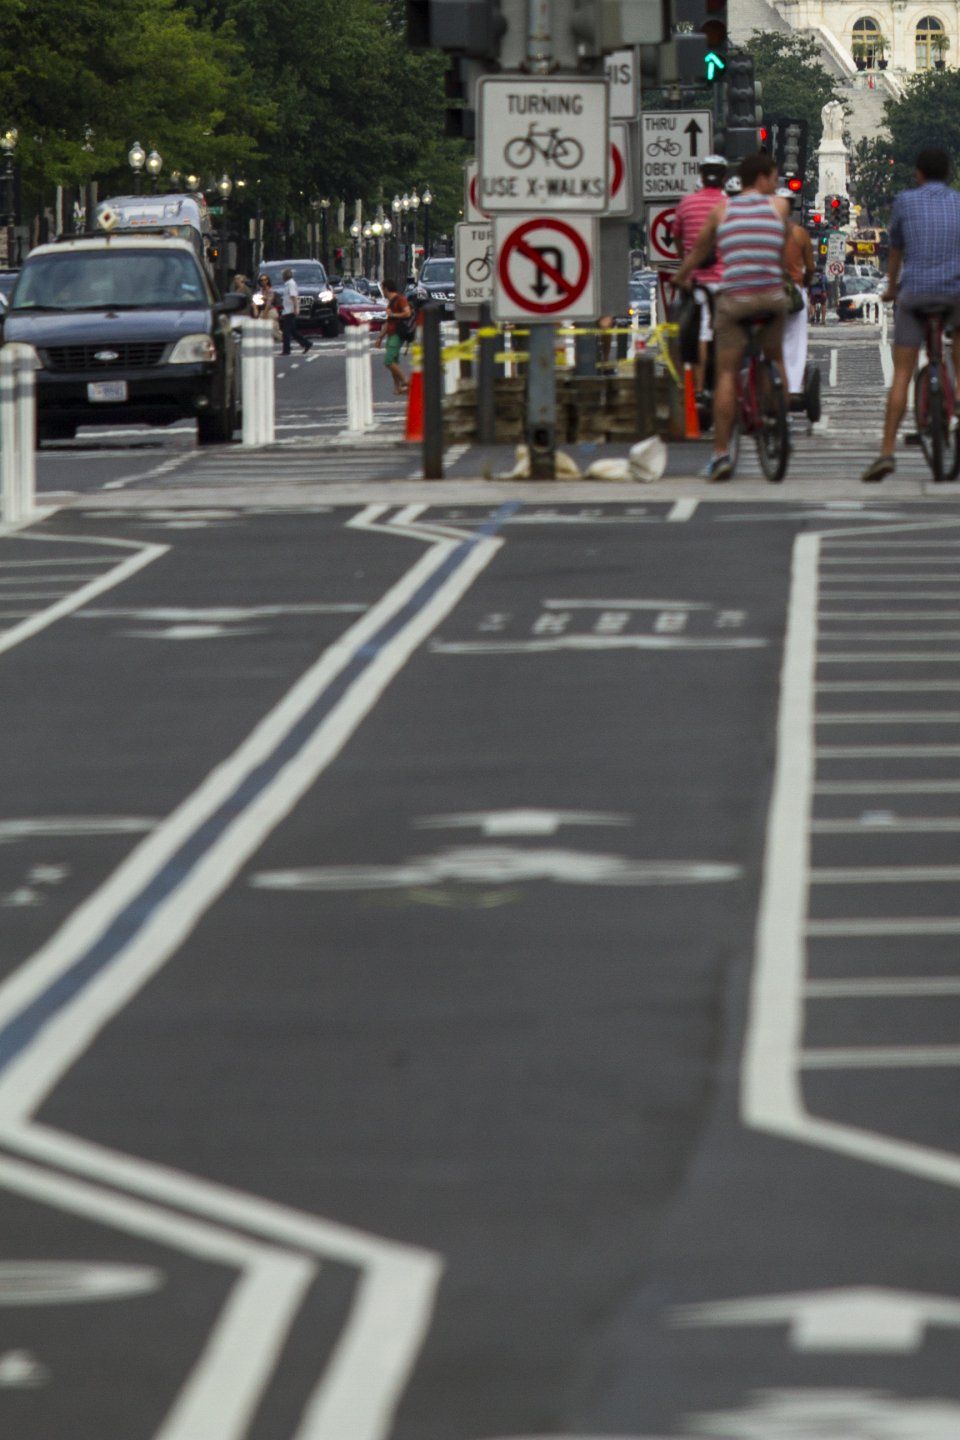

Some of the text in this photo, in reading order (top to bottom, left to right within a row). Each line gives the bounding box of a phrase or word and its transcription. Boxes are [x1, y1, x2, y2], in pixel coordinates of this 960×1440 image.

[507, 94, 584, 115] TURNING
[645, 117, 677, 131] THRU
[645, 162, 702, 176] OBEY THI
[483, 176, 605, 197] USE X-WALKS
[645, 179, 688, 192] SIGNAL
[472, 230, 494, 241] TUR
[465, 287, 484, 298] USE
